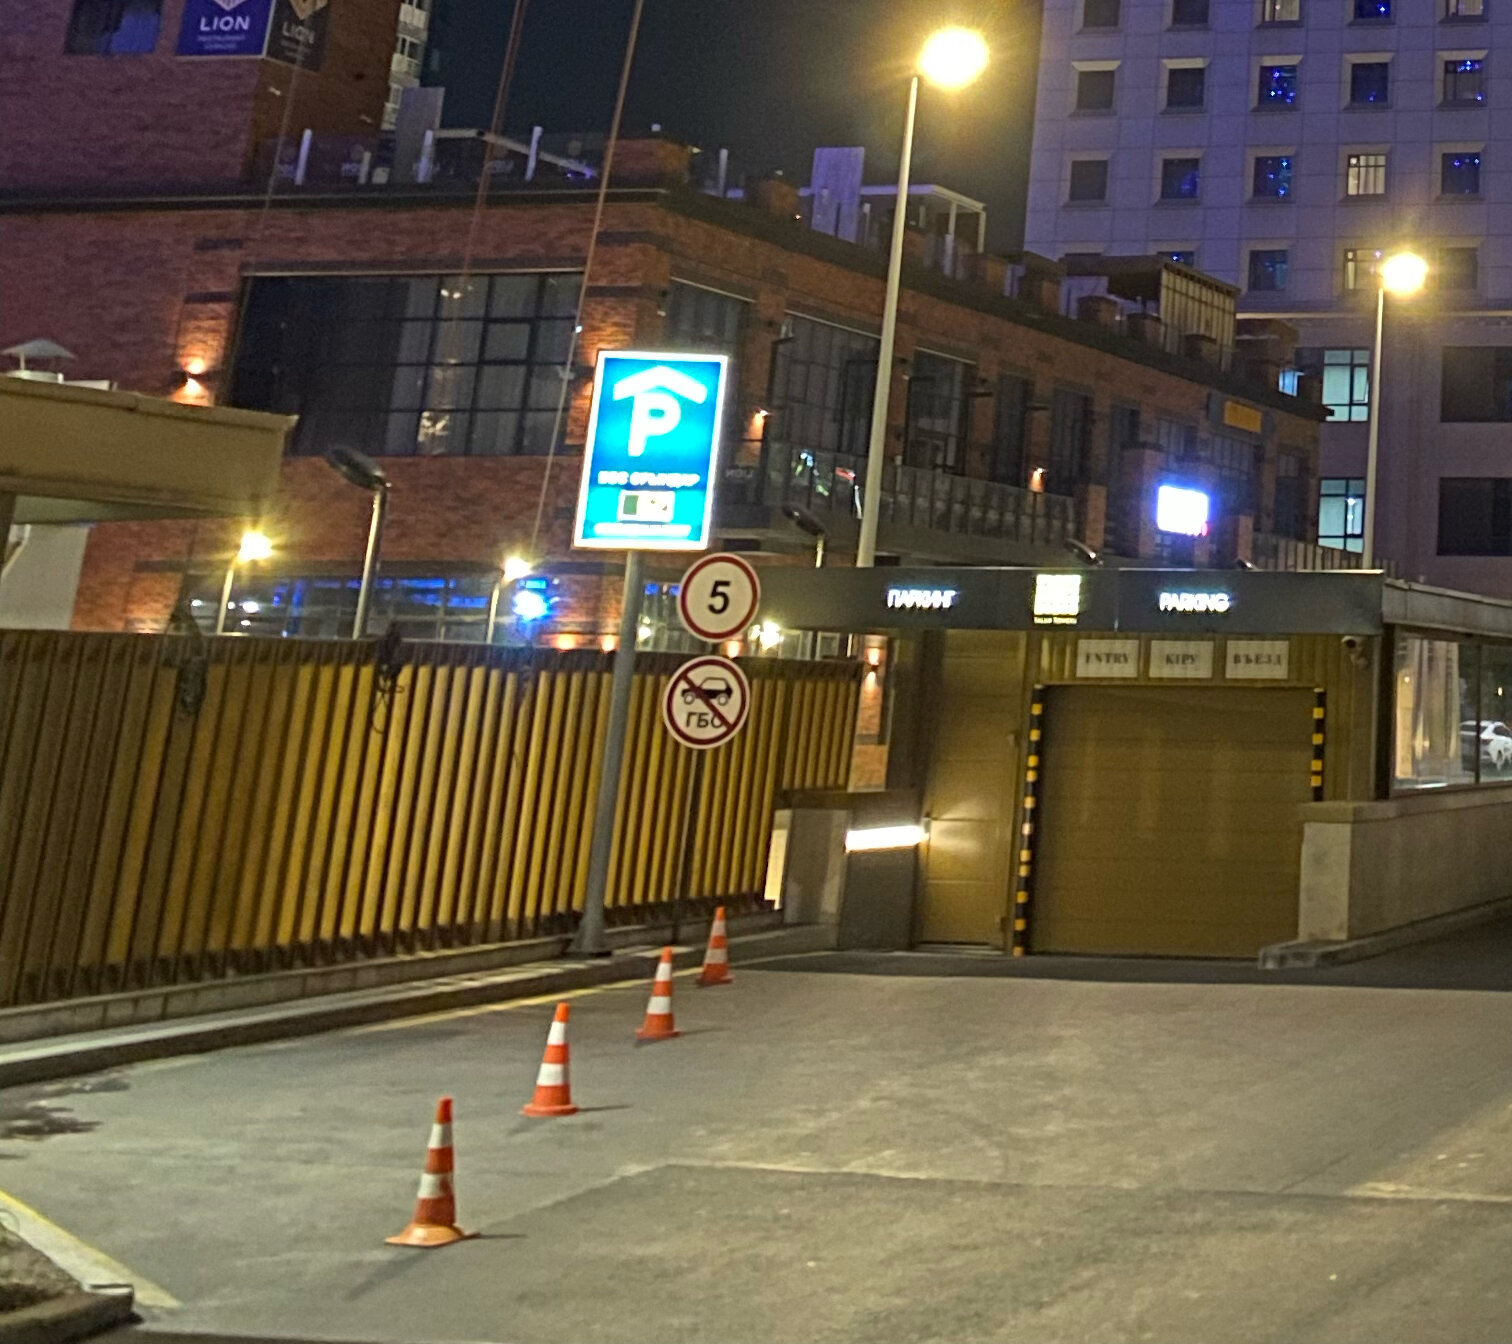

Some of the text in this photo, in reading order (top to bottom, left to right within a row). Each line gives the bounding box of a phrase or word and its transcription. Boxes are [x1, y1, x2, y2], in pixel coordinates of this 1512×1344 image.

[200, 15, 250, 31] LION
[708, 580, 731, 615] 5
[1159, 592, 1230, 612] PARKING
[1086, 652, 1130, 665] ENTRY
